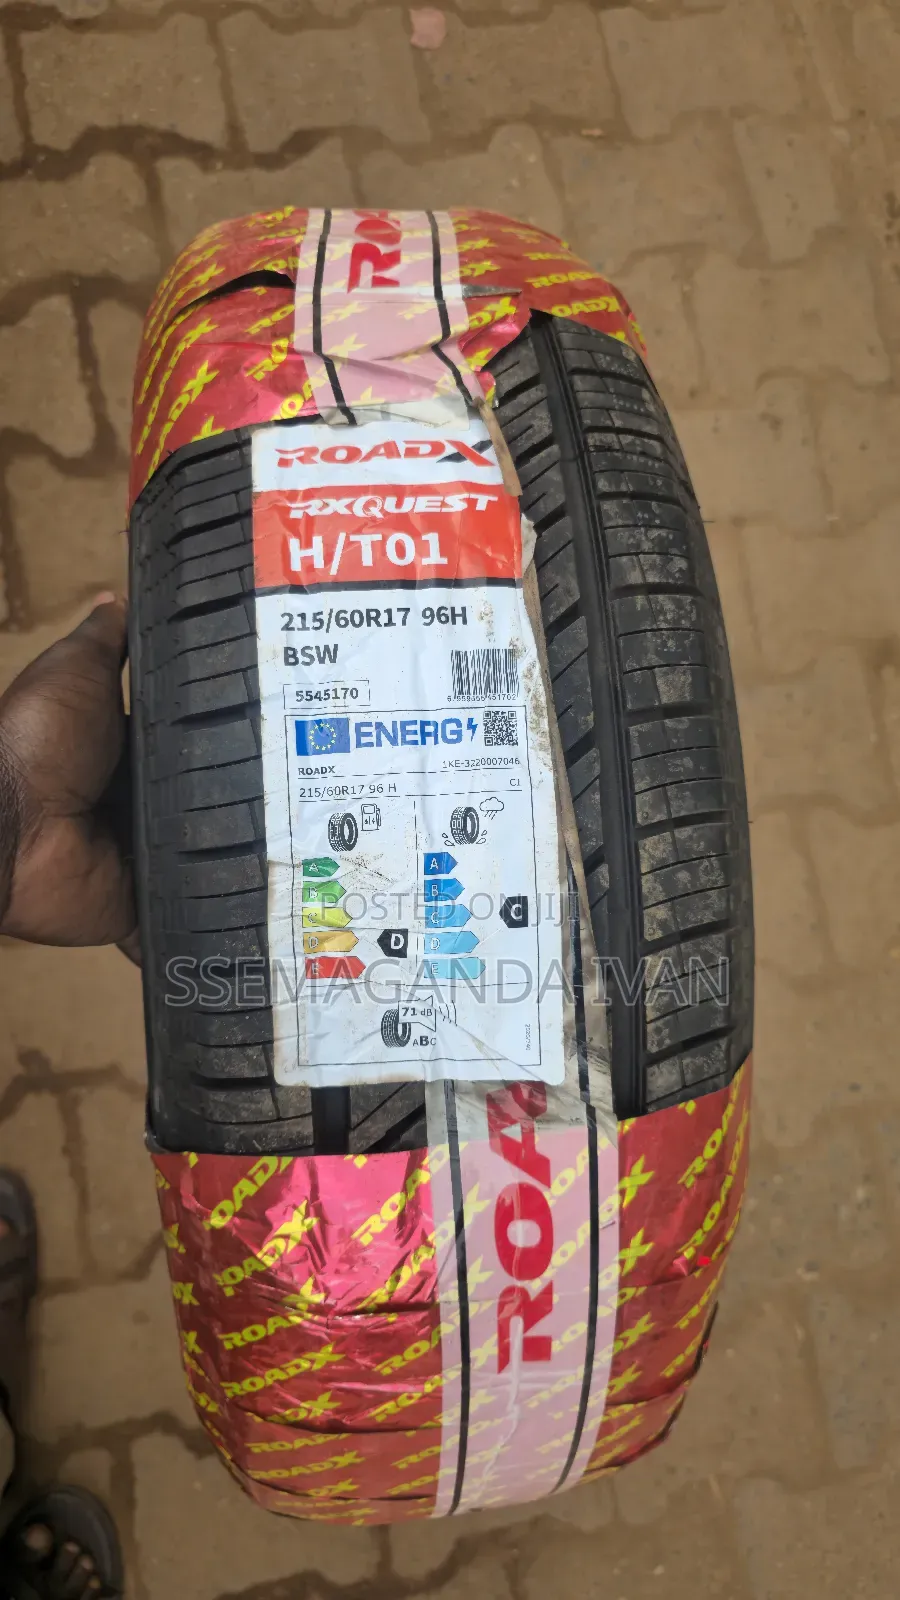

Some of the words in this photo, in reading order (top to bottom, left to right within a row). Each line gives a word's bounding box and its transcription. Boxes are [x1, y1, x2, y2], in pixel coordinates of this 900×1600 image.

[275, 440, 495, 468] ROADX
[288, 493, 498, 519] RXQUEST
[289, 532, 448, 576] H/T01
[280, 607, 411, 633] 215/60R17
[421, 606, 468, 626] 96H
[283, 644, 339, 666] BSW
[295, 687, 359, 702] 5545170
[355, 718, 463, 749] ENERG
[298, 765, 336, 775] ROADX
[299, 784, 365, 798] 215/60R17
[368, 783, 384, 793] 96
[388, 782, 397, 792] H
[308, 862, 319, 872] A
[429, 857, 439, 870] A
[431, 884, 439, 897] B
[307, 911, 318, 924] C
[430, 912, 440, 924] C
[510, 903, 523, 921] C
[308, 936, 319, 949] D
[390, 933, 405, 950] D
[430, 936, 440, 950] D
[431, 962, 439, 974] E
[402, 1007, 417, 1017] 71
[420, 1008, 433, 1017] dB
[220, 1342, 346, 1399] ROADX
[248, 1450, 366, 1480] ROADX
